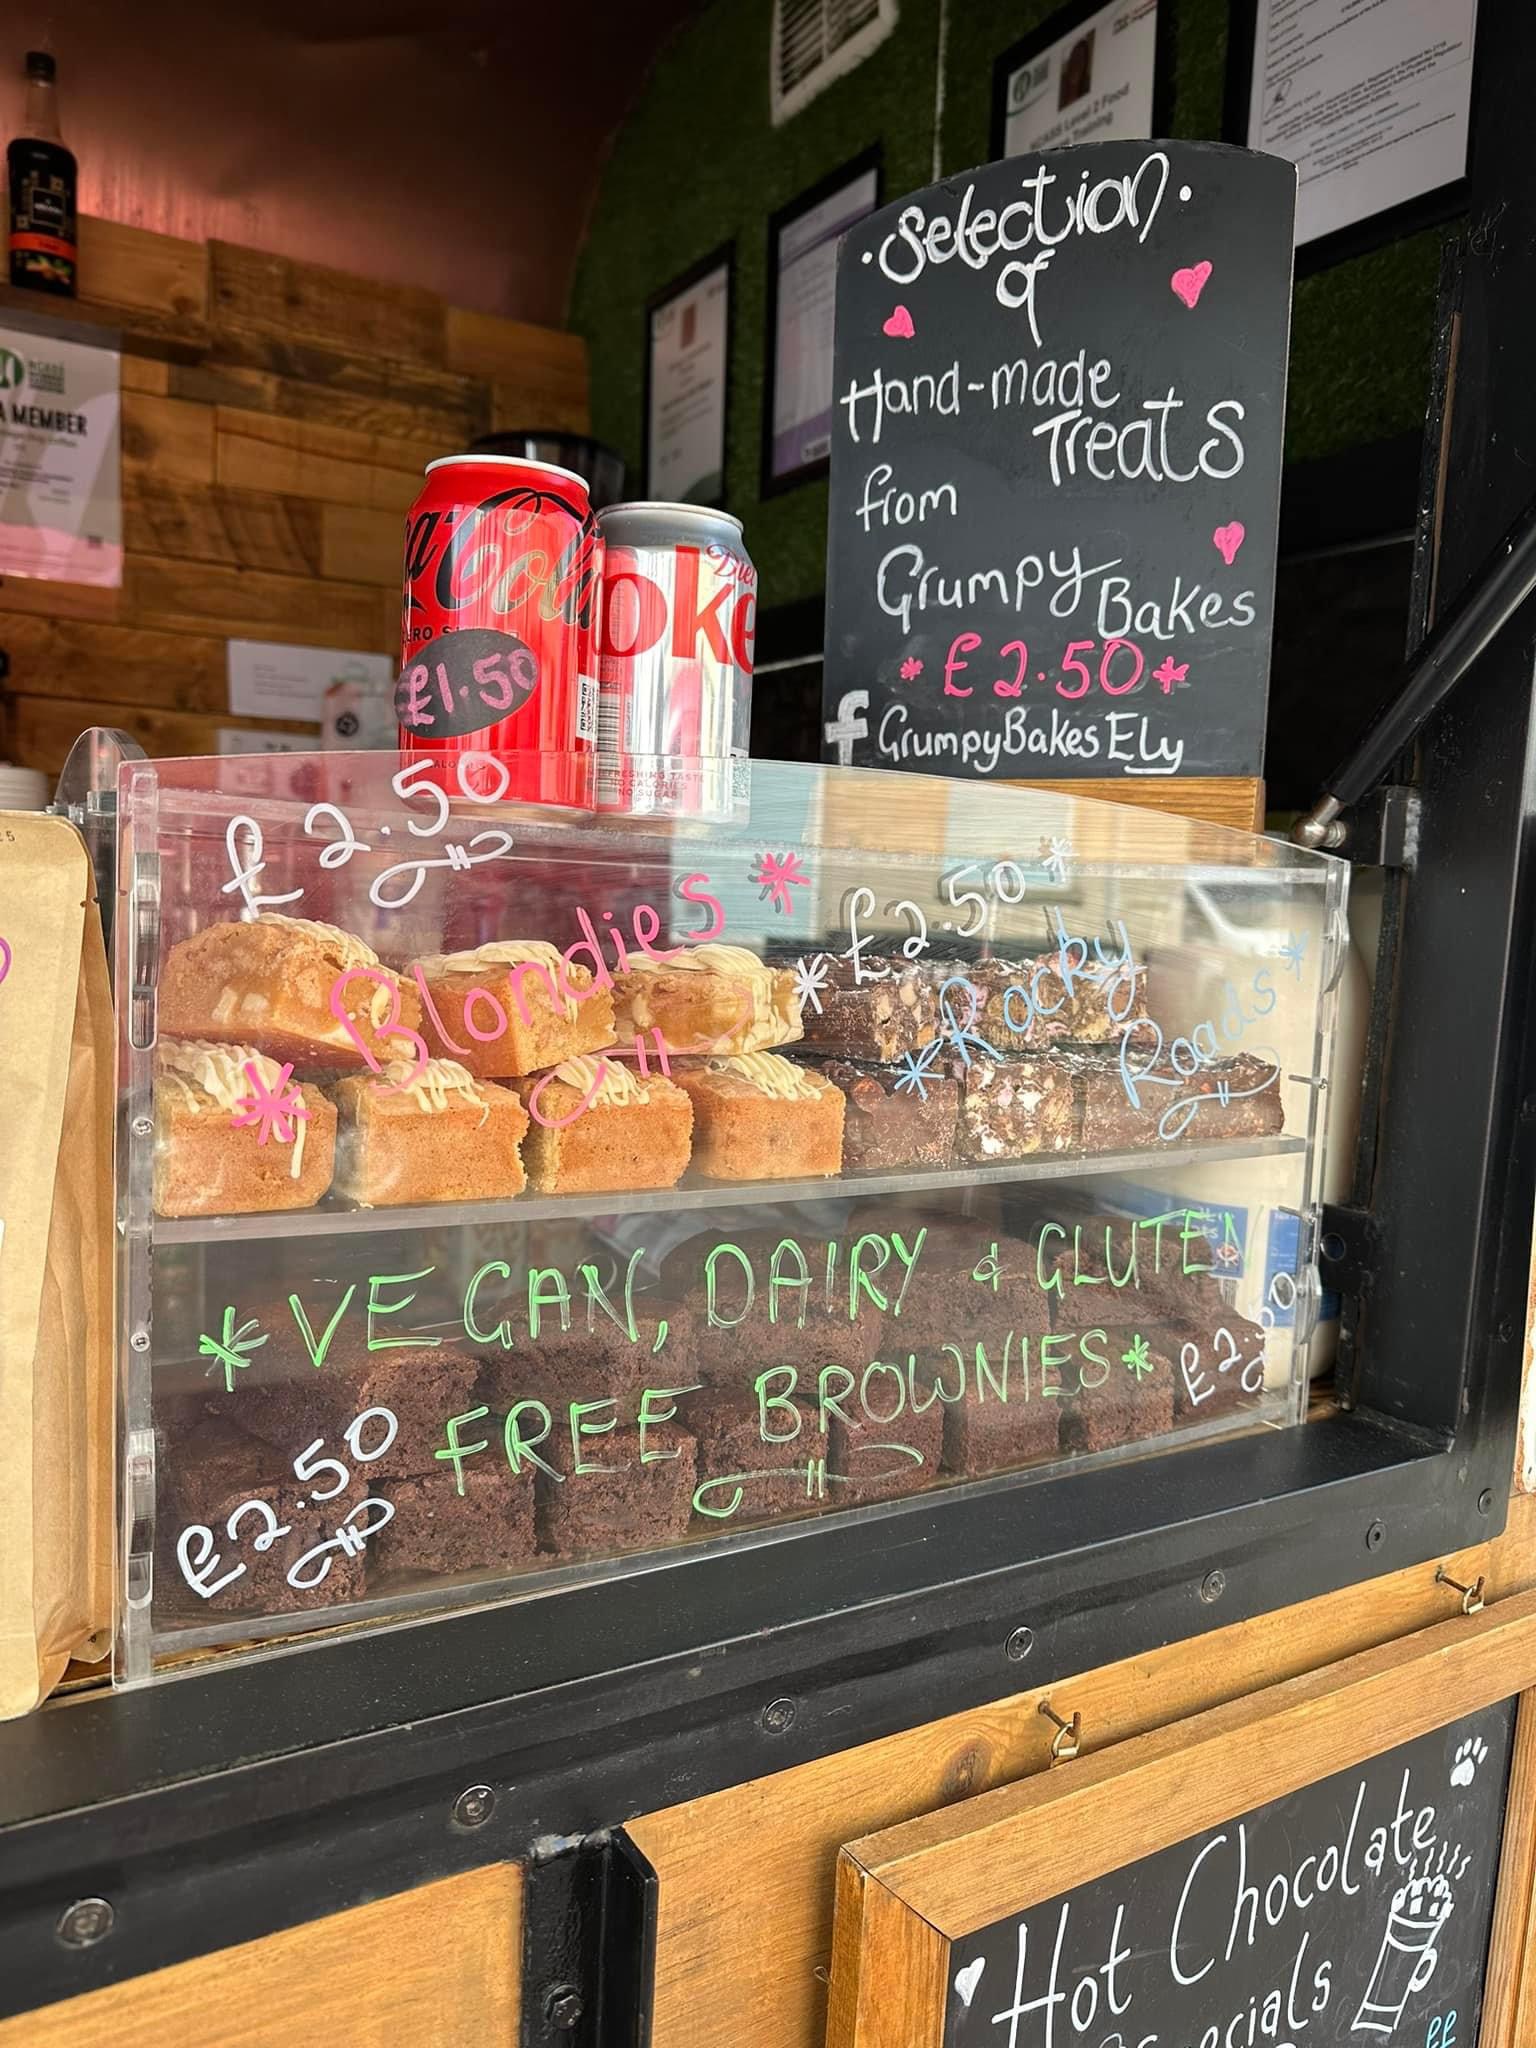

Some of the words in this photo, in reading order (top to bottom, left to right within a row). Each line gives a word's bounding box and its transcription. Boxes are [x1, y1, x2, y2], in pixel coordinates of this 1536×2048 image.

[878, 152, 1169, 283] Selection
[996, 248, 1049, 346] of
[12, 403, 88, 437] MEMBER
[1033, 387, 1245, 487] Treats
[856, 464, 958, 532] from
[593, 544, 756, 675] oke
[876, 543, 1123, 635] Grumpy
[1098, 576, 1257, 641] Bakes
[400, 647, 538, 728] £1.50
[221, 750, 513, 924] £2.50
[330, 872, 727, 1096] Blondies
[845, 860, 1027, 985] £2.50
[939, 905, 1146, 1068] Rocky
[1119, 965, 1278, 1110] Roads
[704, 1225, 928, 1329] DAIRY
[1036, 1205, 1264, 1298] GLUTEN
[434, 1384, 703, 1496] FREE
[754, 1327, 1112, 1443] BROWNIES
[992, 1902, 1134, 2048] Hot
[1170, 1768, 1440, 1987] Chocolate
